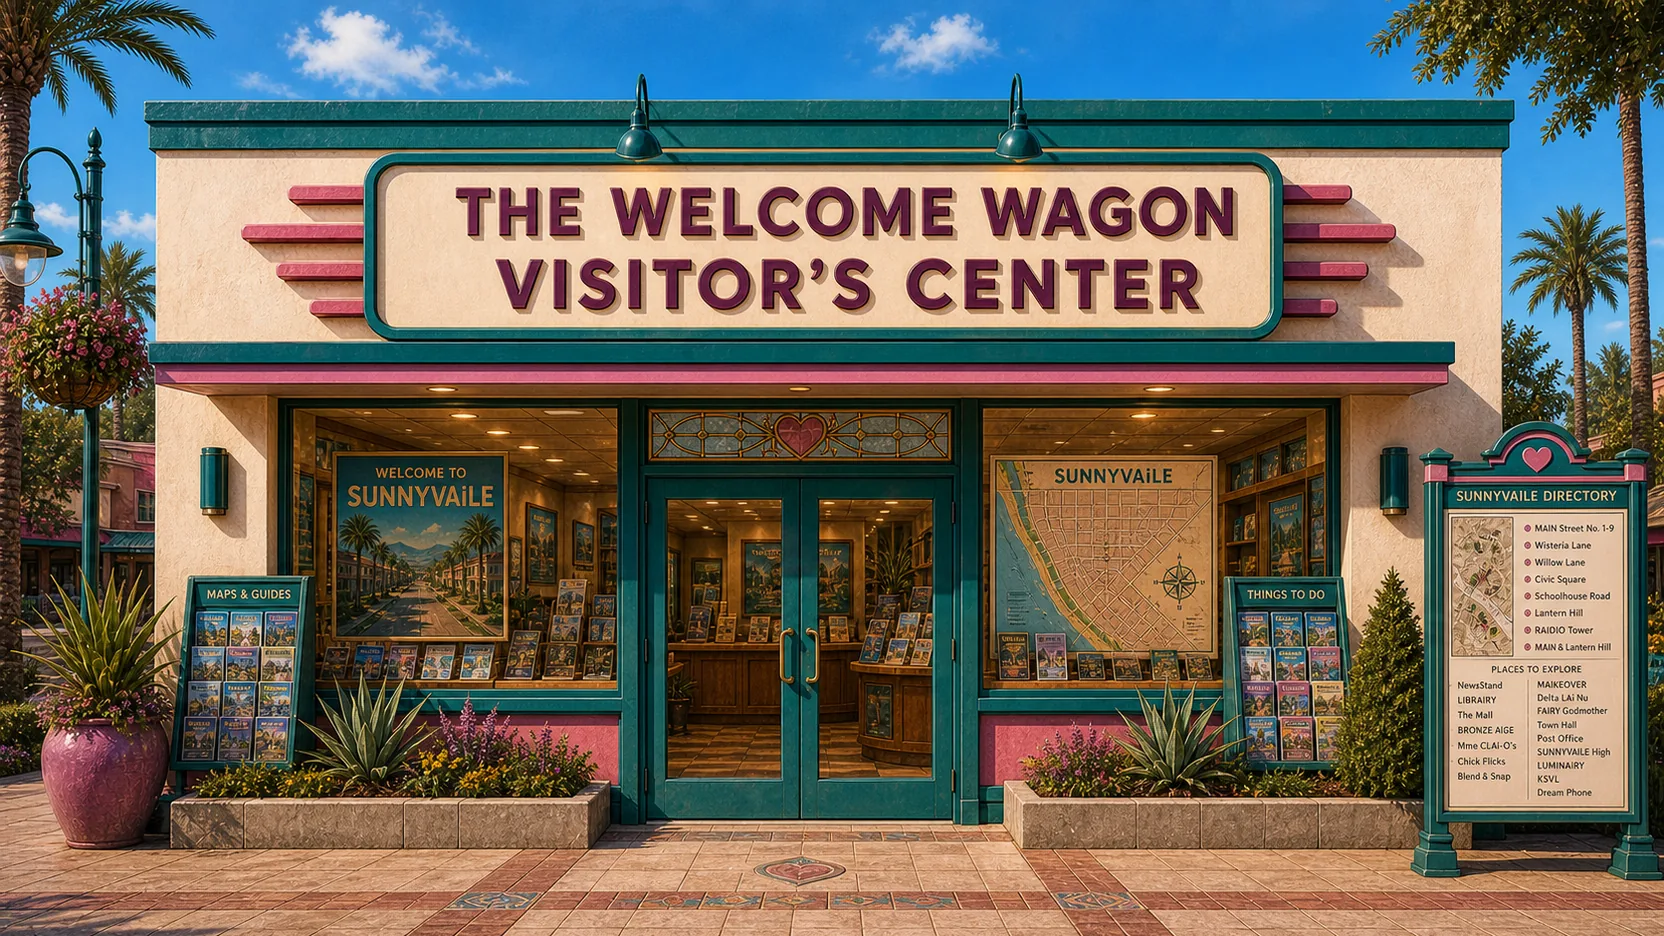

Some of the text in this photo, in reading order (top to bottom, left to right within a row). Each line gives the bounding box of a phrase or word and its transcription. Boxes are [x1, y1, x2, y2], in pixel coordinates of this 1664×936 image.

[455, 186, 1234, 237] THE WELCOME WAGON
[495, 258, 1201, 310] VISITOR’S CENTER
[375, 467, 467, 479] WELCOME TO
[1543, 490, 1617, 502] DIRECTORY
[1534, 524, 1615, 533] MAIN Street No. 1-9
[1534, 541, 1592, 550] Wisteria Lane
[1534, 558, 1586, 567] Willow Lane
[1534, 575, 1587, 586] Civic Square
[206, 589, 291, 600] MAPS & GUIDES
[1247, 589, 1326, 600] THINGS TO DO
[1534, 591, 1611, 601] Schoolhouse Road
[1534, 608, 1584, 618] Lantern Hill
[1534, 625, 1594, 635] RAIDIO Tower
[1534, 642, 1612, 651] MAIN & Lantern Hill
[1491, 665, 1582, 674] PLACES TO EXPLORE
[1457, 681, 1503, 690] NewsStand
[1537, 680, 1587, 689] MAIKEOVER
[1457, 695, 1497, 704] LIBRAIRY
[1537, 693, 1560, 702] Delta
[1576, 693, 1589, 702] Nu
[1457, 710, 1493, 719] The Mall
[1562, 706, 1608, 715] Godmother
[1537, 720, 1577, 729] Town Hall
[1457, 726, 1493, 735] BRONZE
[1537, 733, 1584, 743] Post Office
[1457, 741, 1479, 750] Mme
[1591, 747, 1611, 759] High
[1457, 756, 1506, 766] Chick Flicks
[1457, 771, 1512, 783] Blend & Snap
[1537, 774, 1560, 784] KSVL
[1537, 788, 1593, 797] Dream Phone
